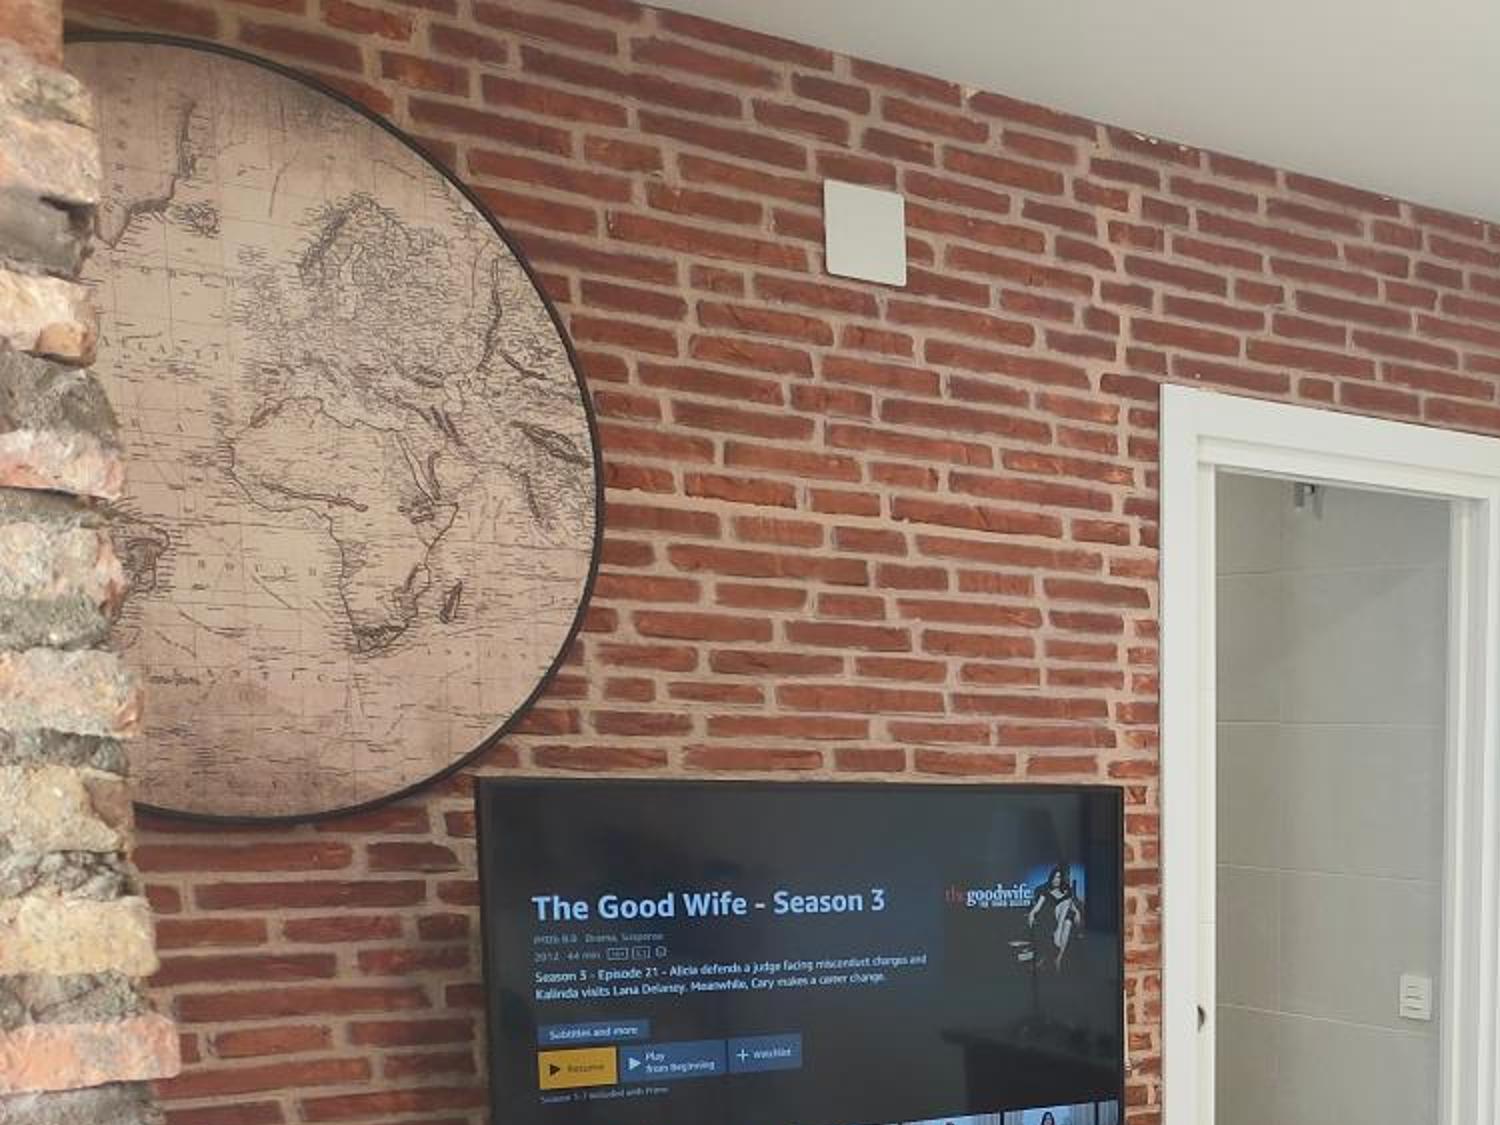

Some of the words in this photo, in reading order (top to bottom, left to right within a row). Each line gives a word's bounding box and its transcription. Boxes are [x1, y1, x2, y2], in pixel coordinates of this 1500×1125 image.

[531, 895, 589, 921] The
[599, 892, 675, 919] Good
[682, 890, 747, 917] Wife
[773, 890, 864, 915] Season
[871, 888, 885, 912] 3
[535, 970, 577, 984] Season
[598, 966, 642, 982] Episode
[670, 964, 698, 977] Alicia
[700, 961, 741, 976] defends
[753, 962, 780, 975] judge
[783, 959, 814, 972] facing
[535, 986, 579, 1000] Kalinda
[582, 985, 610, 998] visits
[613, 984, 639, 996] Lana
[752, 977, 775, 990] Cary
[777, 975, 808, 987] makes
[594, 1026, 611, 1037] and
[613, 1026, 638, 1036] more
[646, 1051, 665, 1063] Play
